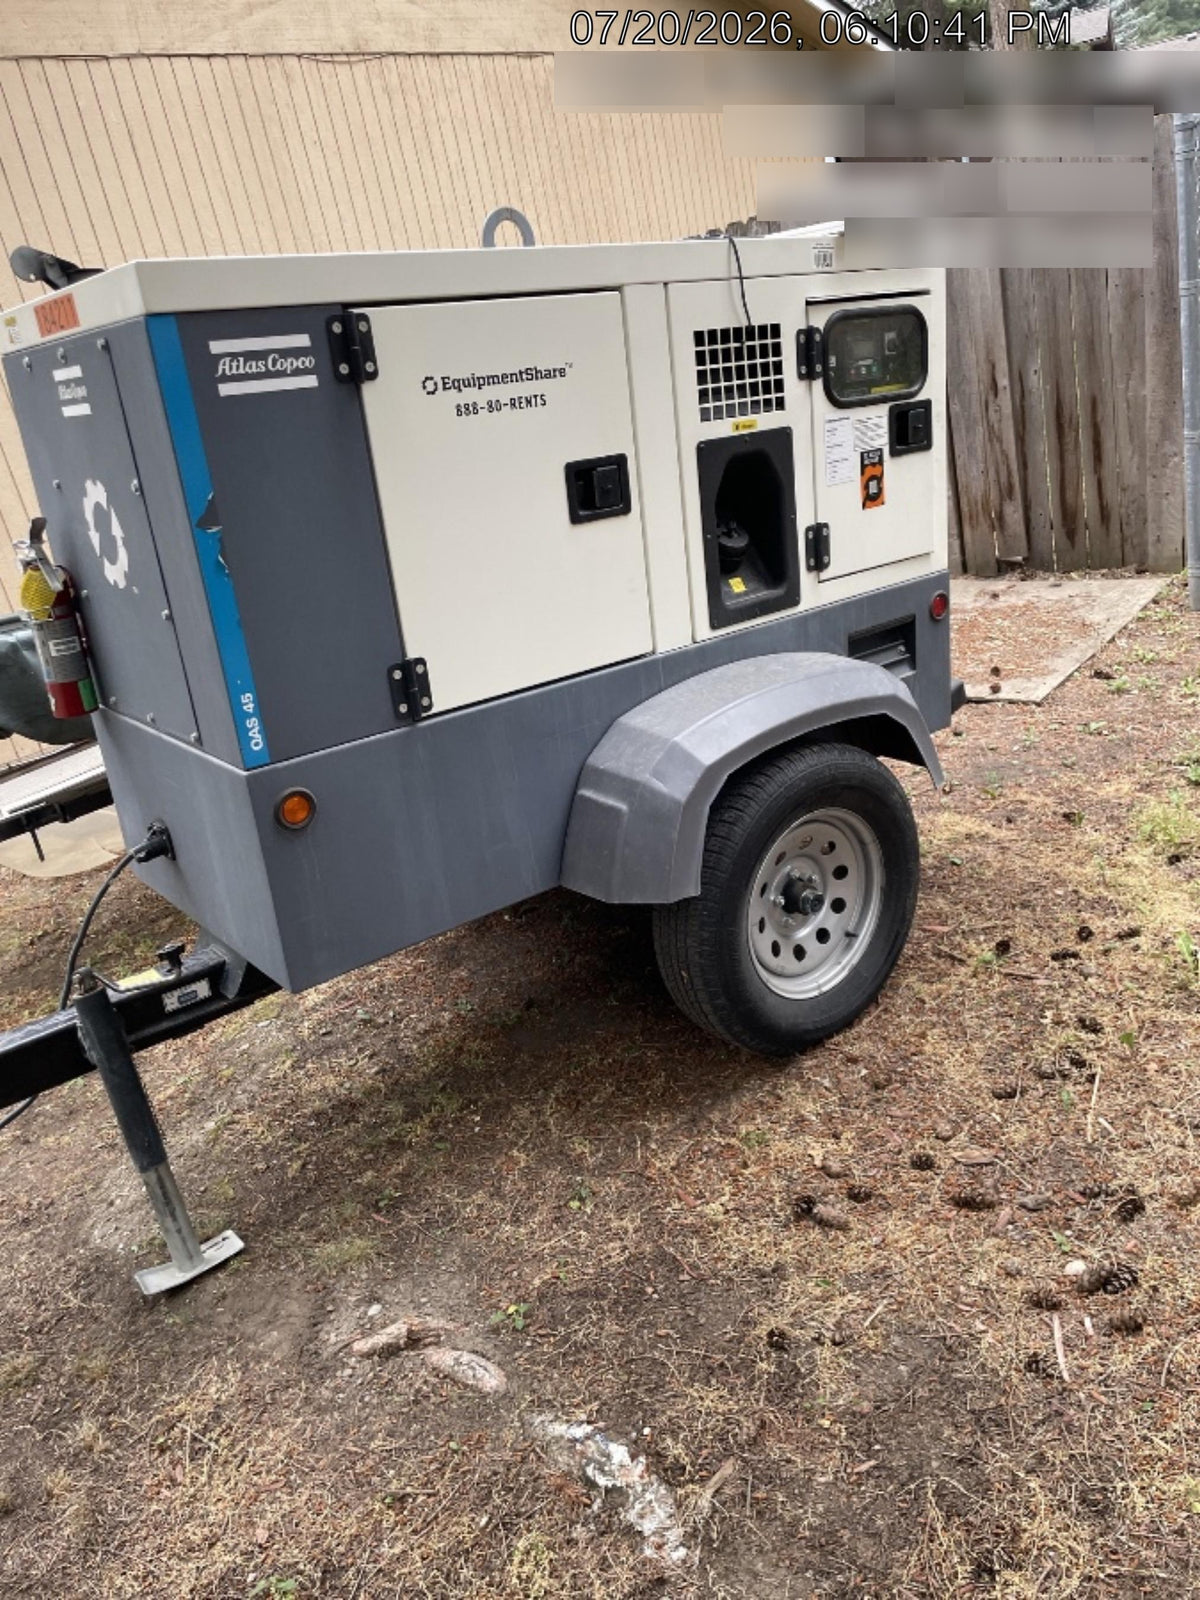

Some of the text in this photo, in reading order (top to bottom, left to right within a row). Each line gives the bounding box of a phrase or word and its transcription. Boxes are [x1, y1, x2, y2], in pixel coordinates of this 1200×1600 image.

[215, 354, 316, 378] Atlas Copco
[455, 394, 547, 417] 888-80-RENTS
[241, 692, 264, 751] QAS 45
